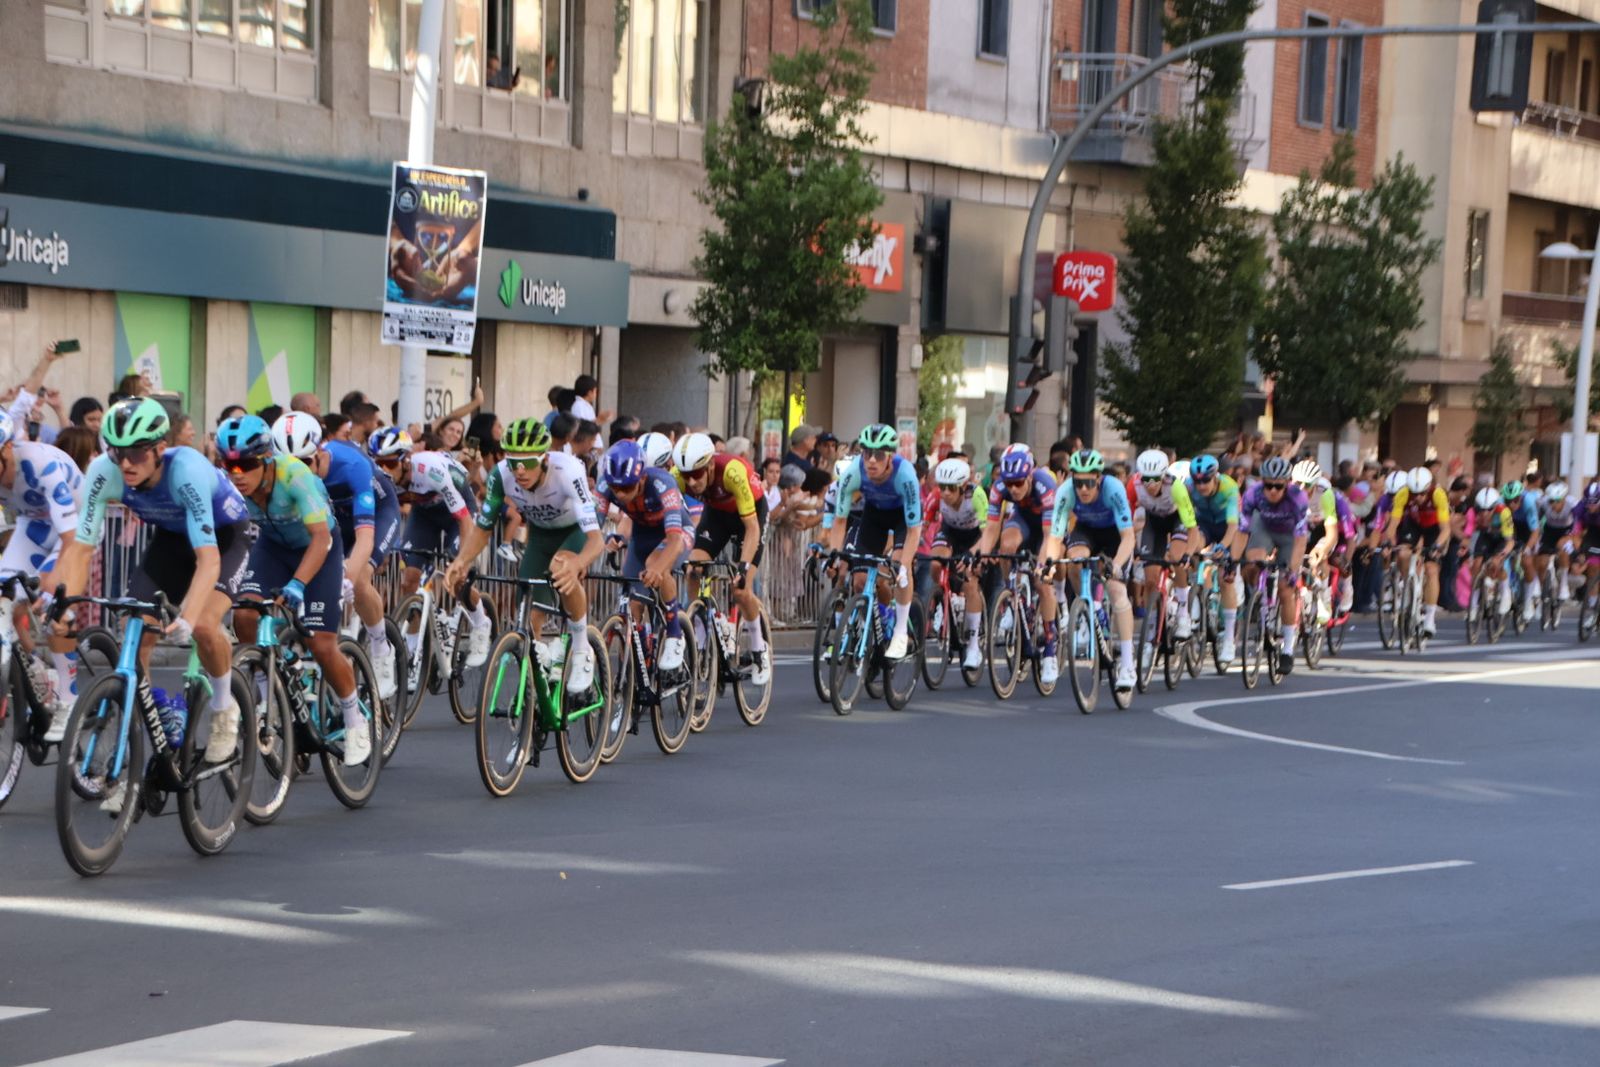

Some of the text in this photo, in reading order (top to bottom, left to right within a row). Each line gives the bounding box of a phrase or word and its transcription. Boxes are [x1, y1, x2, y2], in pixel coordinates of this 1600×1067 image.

[420, 190, 478, 219] Artifice
[1063, 260, 1105, 278] Prima
[522, 279, 566, 314] Unicaja
[139, 676, 168, 754] VAN RYSEL
